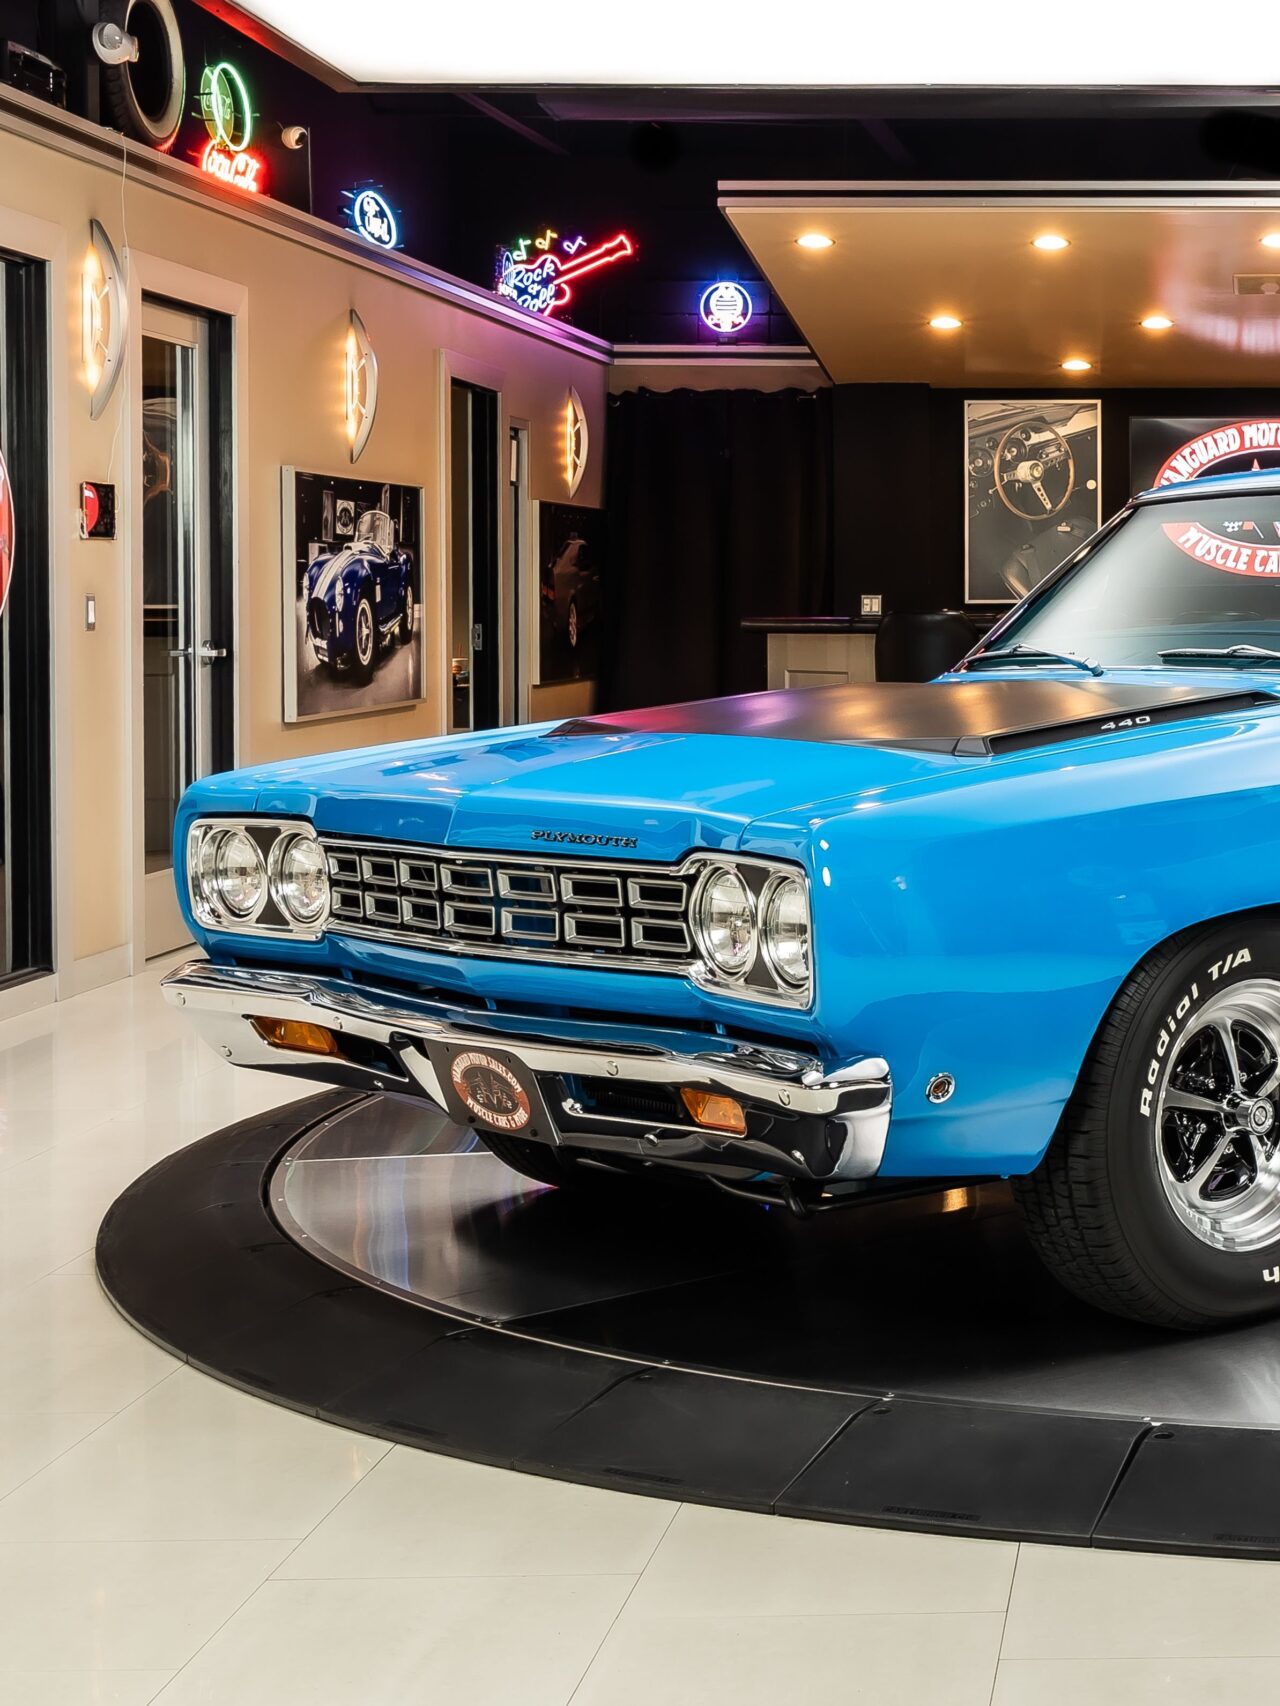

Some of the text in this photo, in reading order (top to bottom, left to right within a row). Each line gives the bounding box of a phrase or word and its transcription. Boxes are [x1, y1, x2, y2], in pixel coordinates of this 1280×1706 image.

[510, 256, 556, 288] Rock
[1160, 427, 1241, 486] ANGUARD
[1177, 526, 1251, 572] MUSCLE
[1100, 715, 1151, 730] 440
[530, 830, 639, 848] PLYMOUTH
[1139, 948, 1252, 1117] Radial T/A
[466, 1096, 494, 1123] MUSCLE
